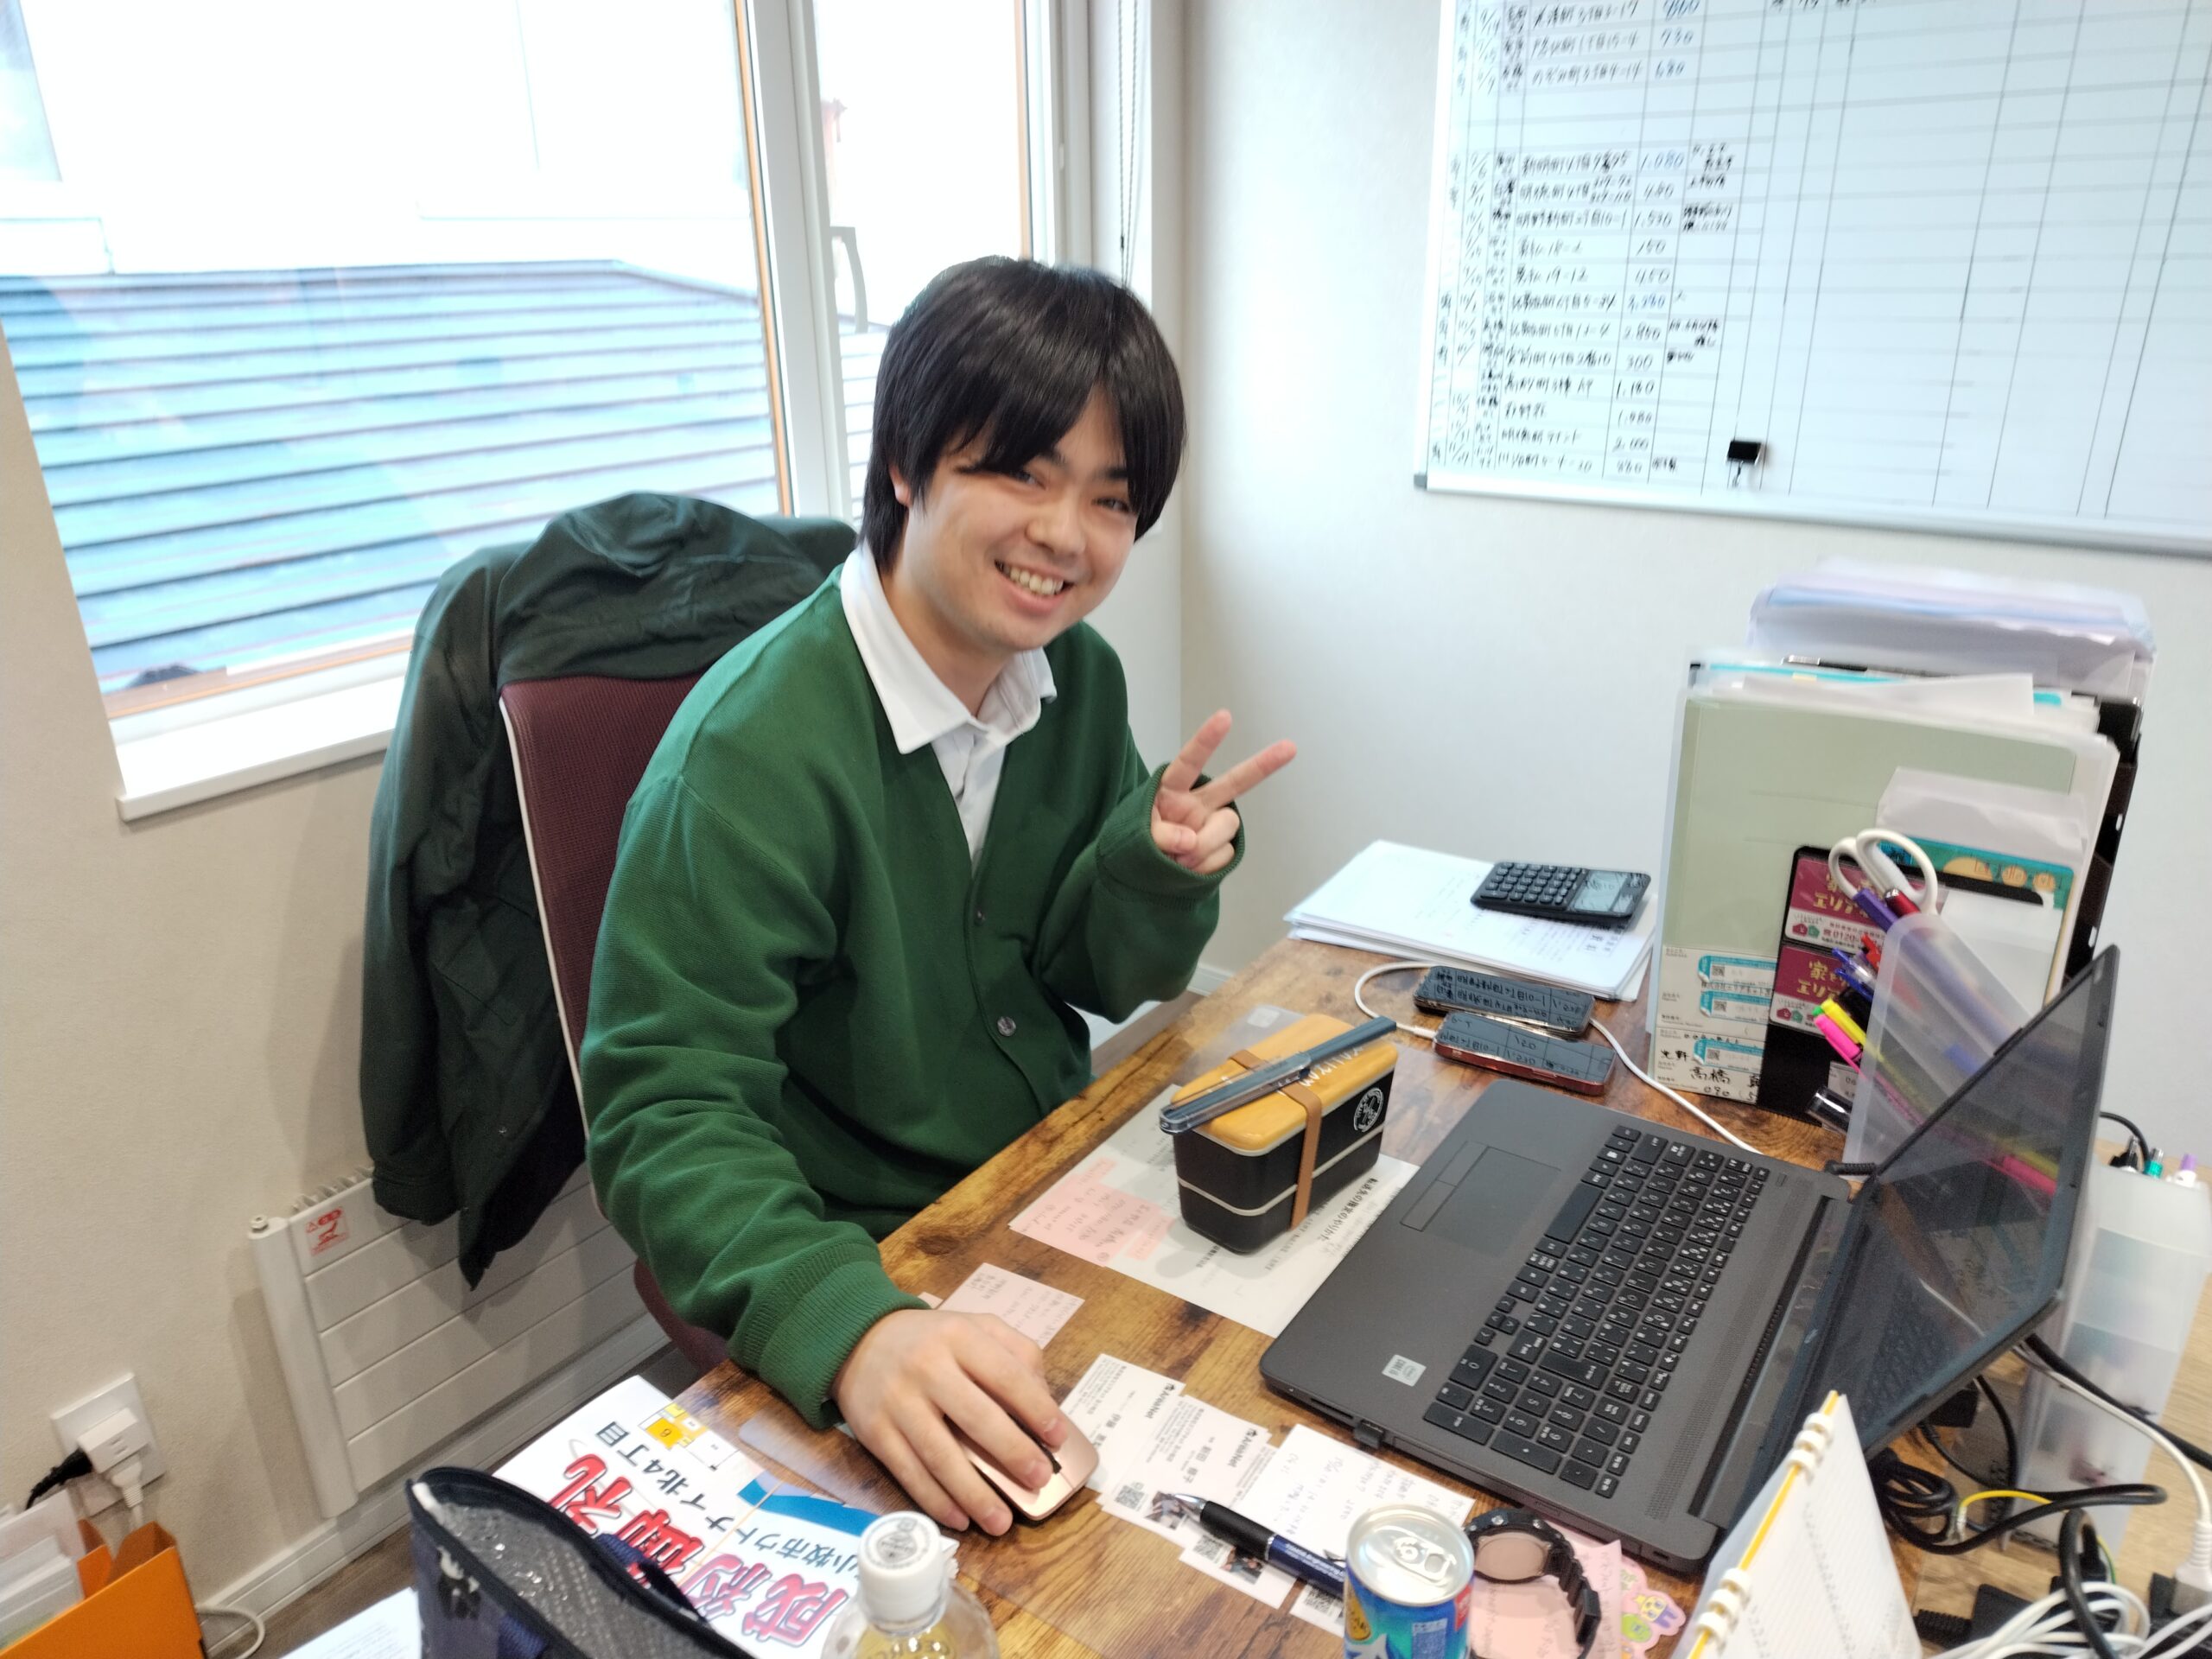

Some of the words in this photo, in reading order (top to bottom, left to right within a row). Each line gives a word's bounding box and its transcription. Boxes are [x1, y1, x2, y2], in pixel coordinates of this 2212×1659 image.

[548, 1452, 851, 1649] 成約御礼
[595, 1420, 860, 1580] 小牧市ウトナイ北4丁目
